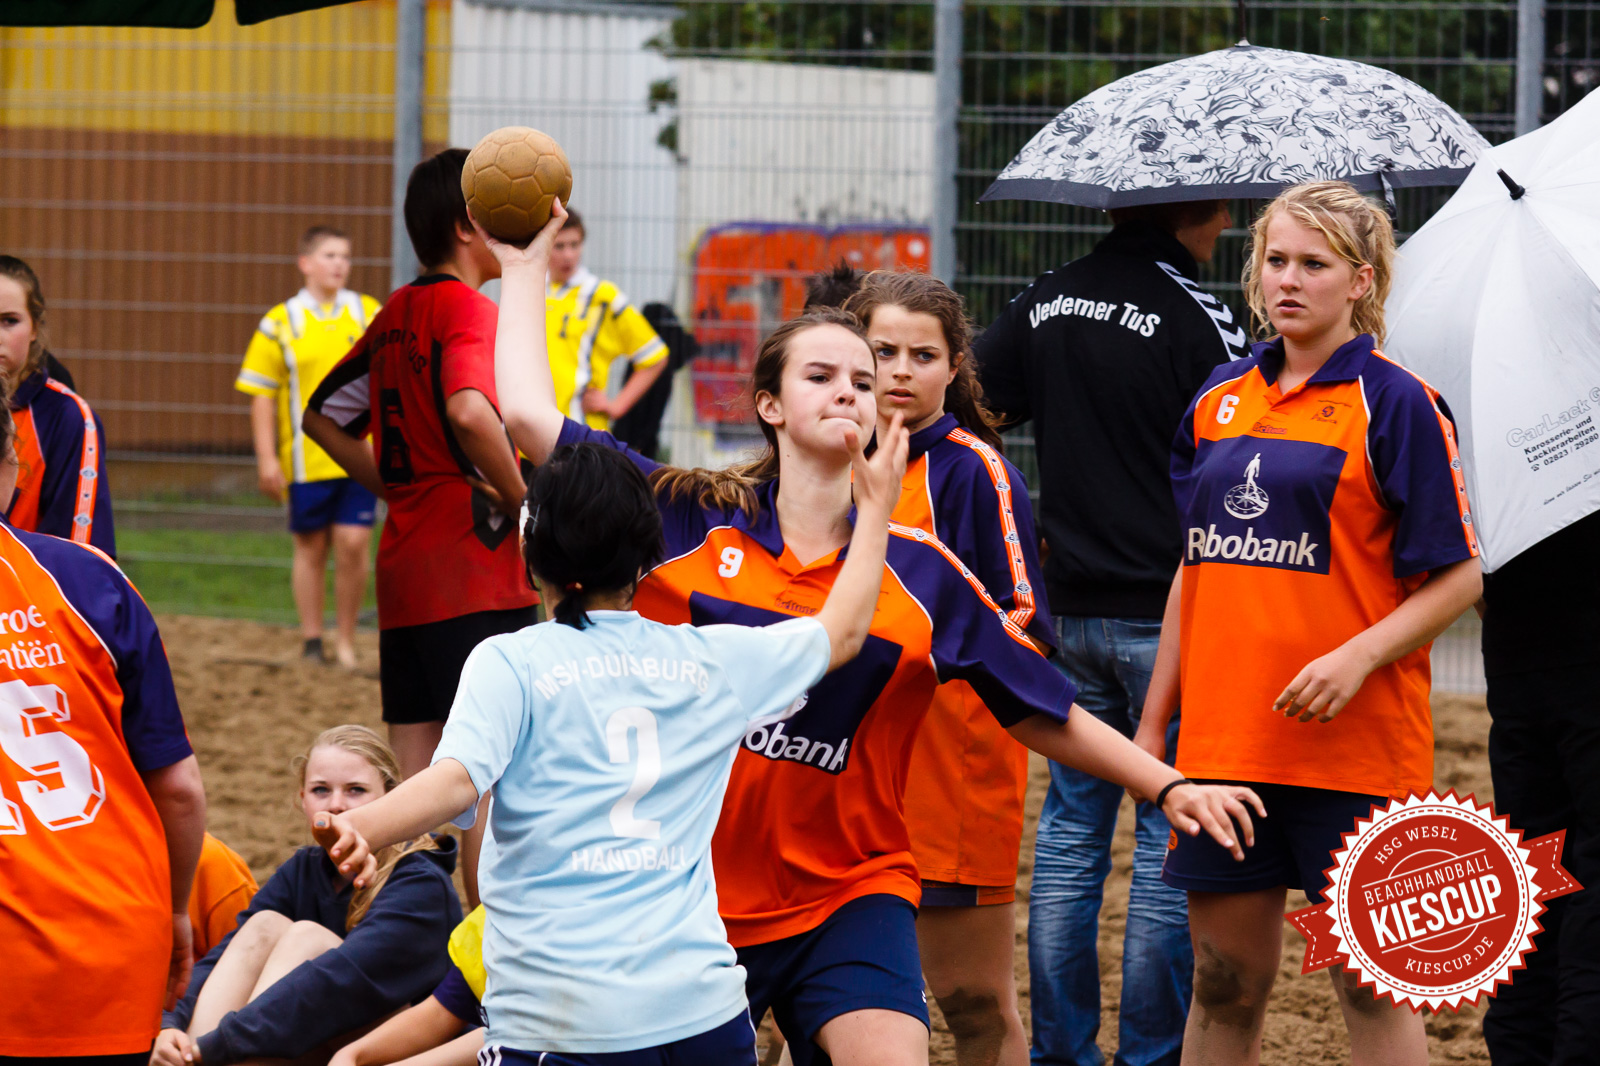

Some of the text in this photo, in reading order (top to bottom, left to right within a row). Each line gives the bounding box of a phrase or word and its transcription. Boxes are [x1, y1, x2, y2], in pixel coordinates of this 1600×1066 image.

[1029, 294, 1161, 337] Uedemer TuS
[1216, 394, 1240, 424] 6
[1506, 400, 1591, 447] CarLack
[1524, 416, 1592, 455] Karosserie- und
[1527, 425, 1596, 463] Lackierarbeiten
[1543, 449, 1569, 466] 02823
[718, 546, 744, 578] 9
[1188, 524, 1318, 567] Rbobank
[0, 604, 47, 635] roe
[0, 639, 66, 670] atiën
[0, 679, 106, 835] 5
[745, 722, 849, 771] obank
[605, 707, 661, 840] 2
